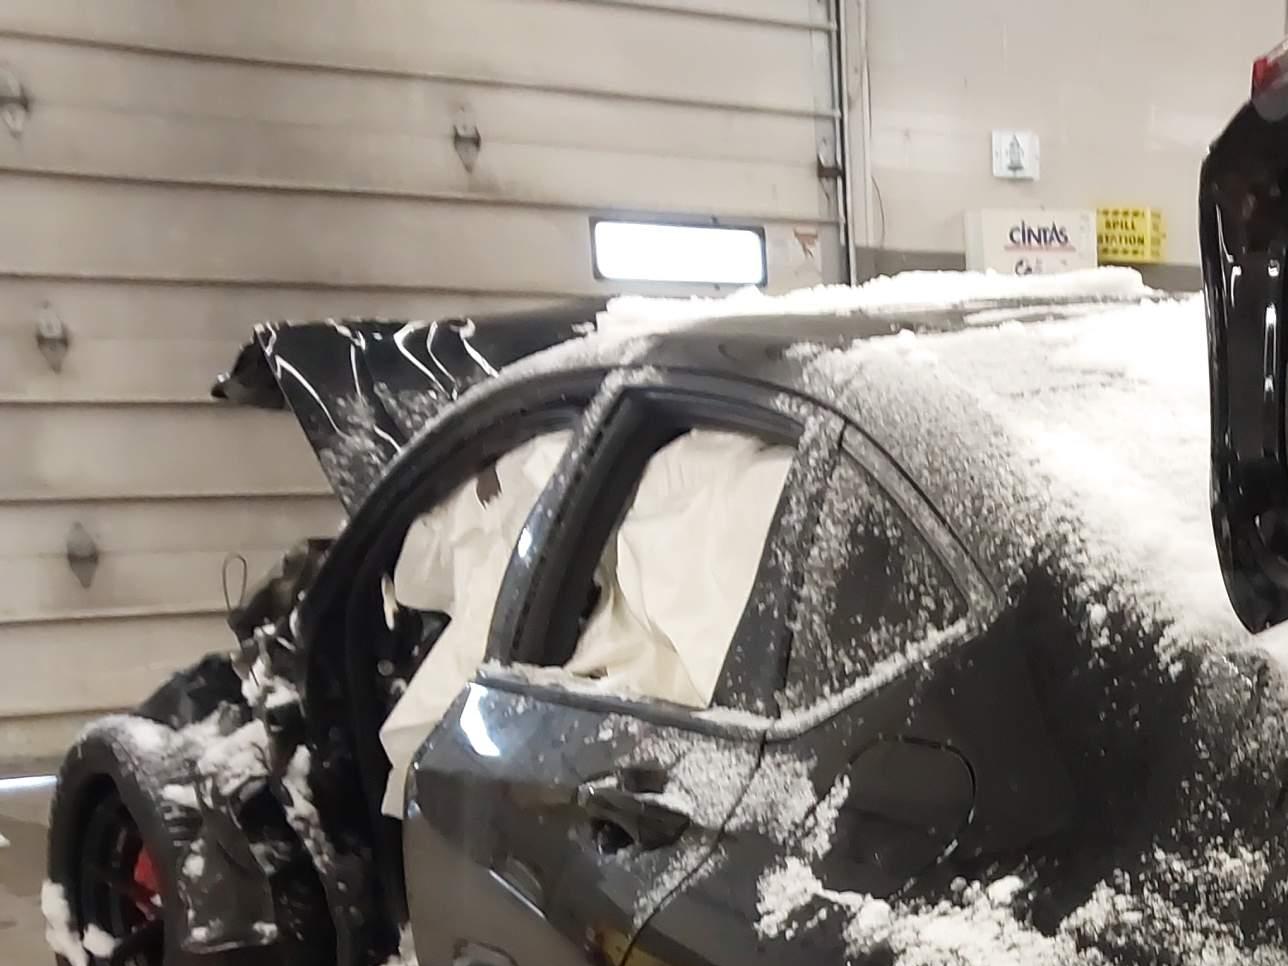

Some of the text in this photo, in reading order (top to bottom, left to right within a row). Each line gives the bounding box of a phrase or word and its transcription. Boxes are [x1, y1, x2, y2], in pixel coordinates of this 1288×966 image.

[1104, 219, 1136, 231] SPILL
[1009, 219, 1069, 245] CINTAS
[1097, 234, 1145, 246] STATION
